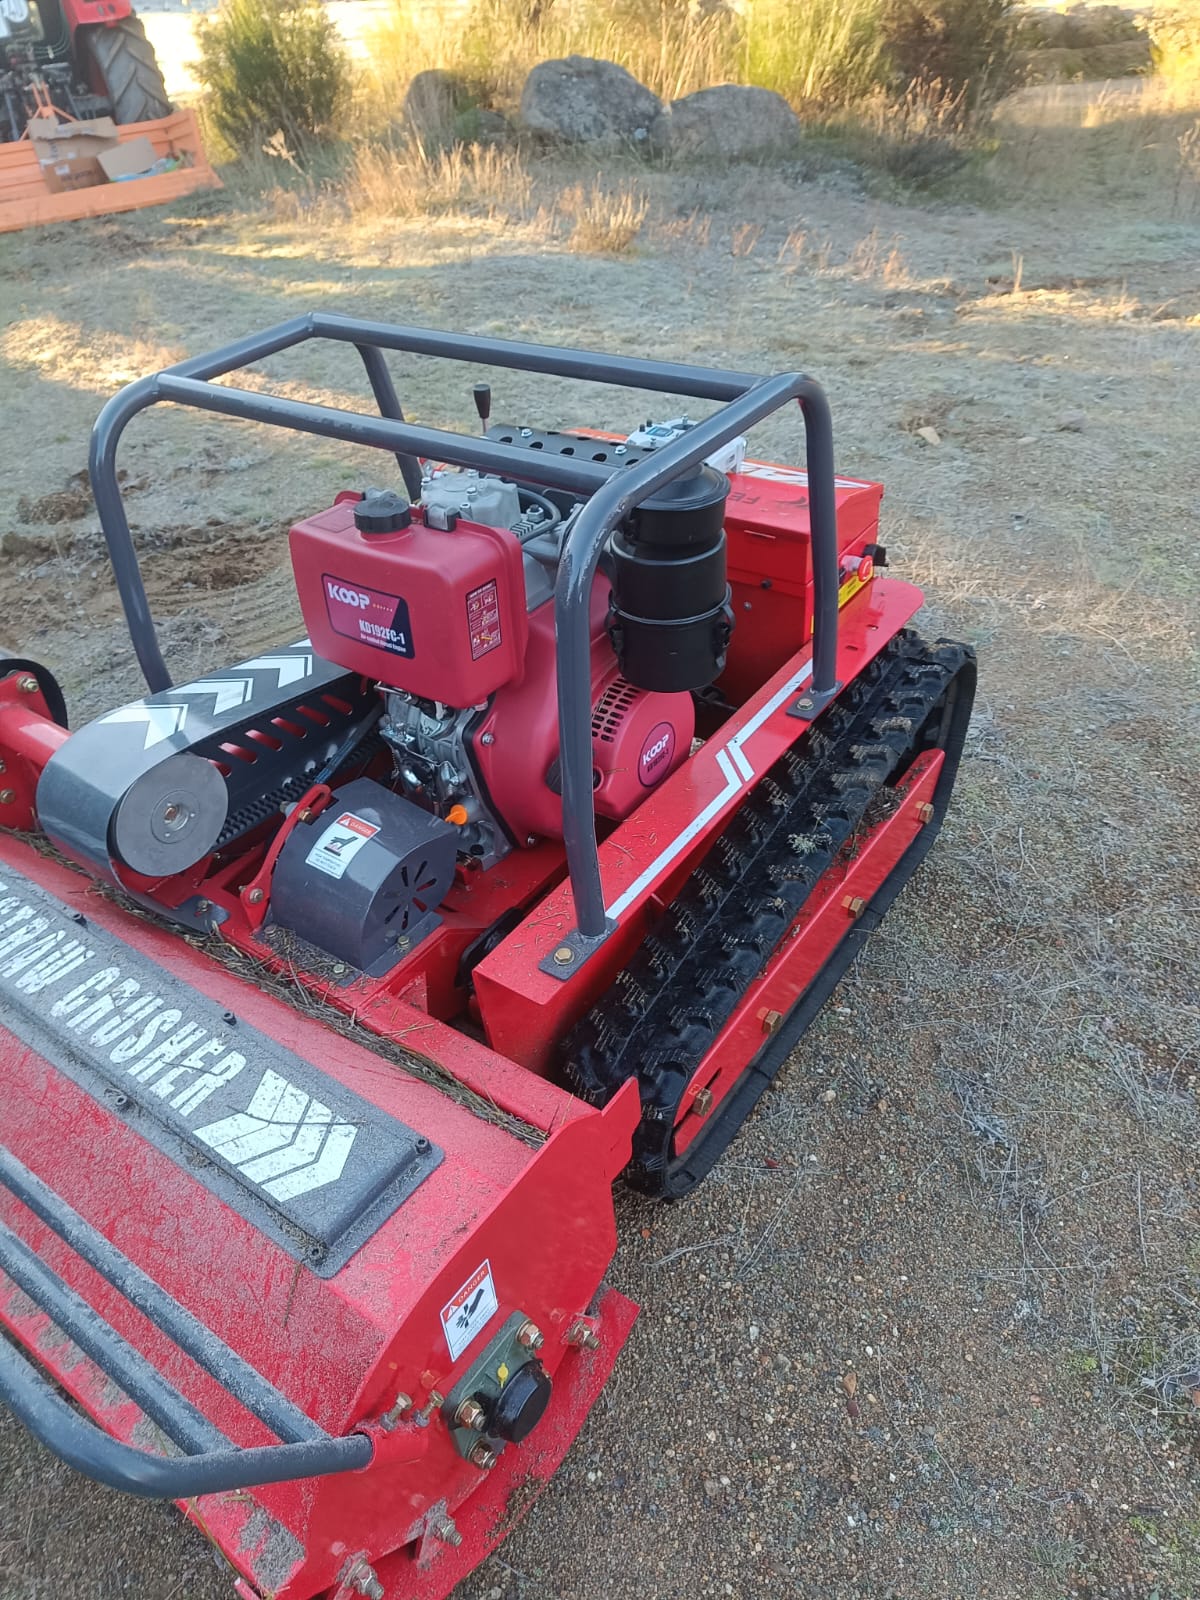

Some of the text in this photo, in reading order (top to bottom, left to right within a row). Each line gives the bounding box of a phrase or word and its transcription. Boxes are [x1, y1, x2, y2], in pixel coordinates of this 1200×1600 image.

[327, 582, 370, 610] KOOP
[642, 734, 669, 766] KOOP
[0, 896, 248, 1118] TRAW CRUSHER
[458, 1270, 486, 1303] DANGER
